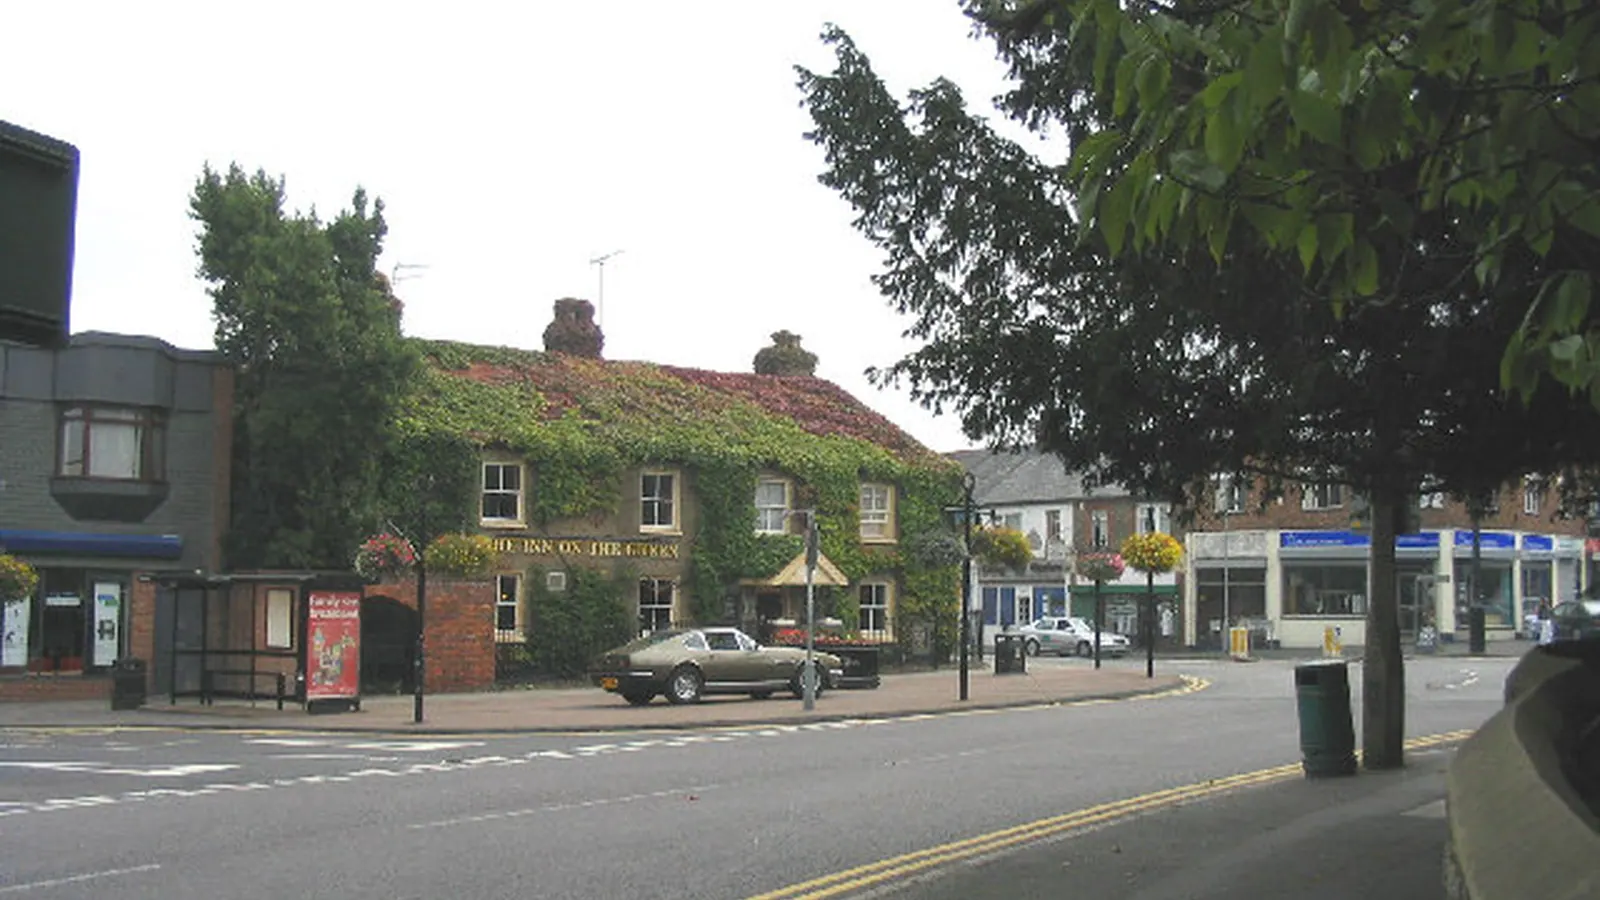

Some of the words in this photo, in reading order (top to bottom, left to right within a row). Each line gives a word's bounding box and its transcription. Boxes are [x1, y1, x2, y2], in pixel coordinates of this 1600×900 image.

[489, 539, 513, 552] HE
[522, 539, 552, 553] INN
[557, 541, 581, 555] ON
[587, 541, 621, 556] THE
